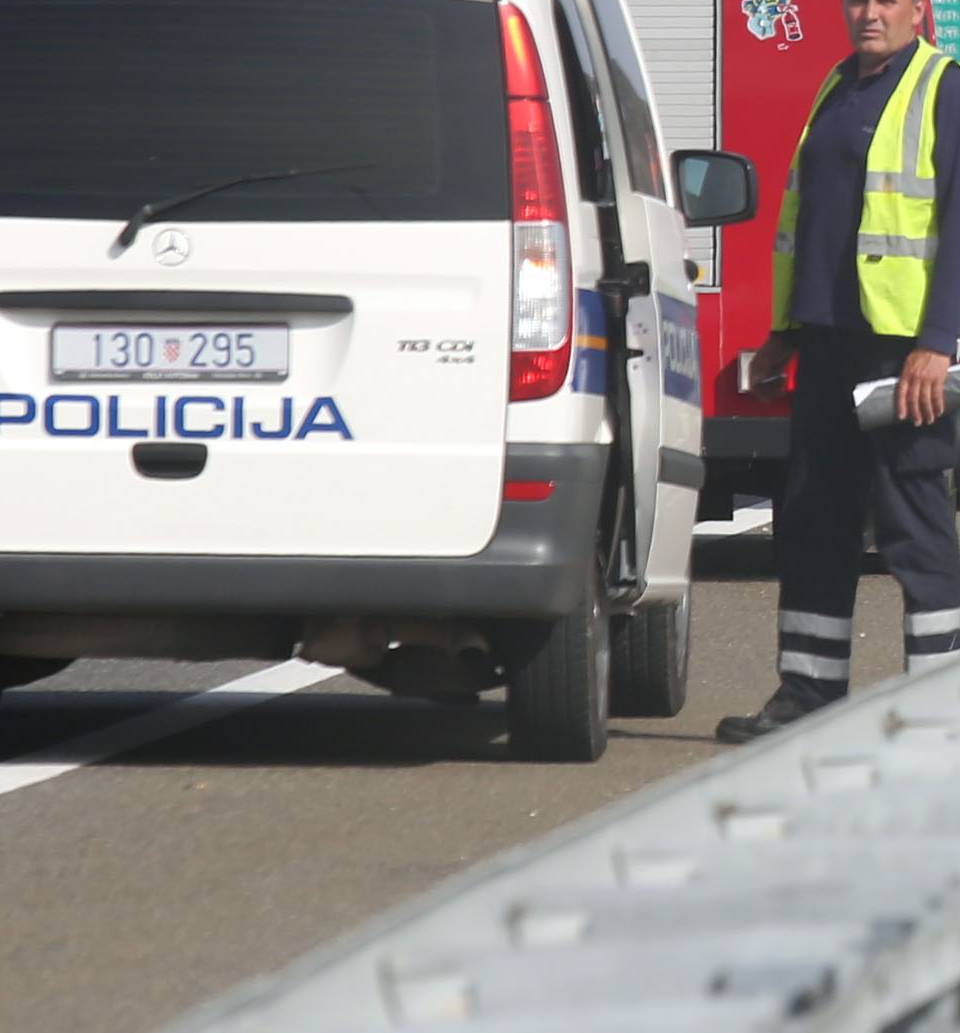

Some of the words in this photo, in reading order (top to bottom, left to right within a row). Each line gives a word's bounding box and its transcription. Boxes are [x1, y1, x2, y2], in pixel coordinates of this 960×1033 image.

[93, 332, 154, 368] 130
[188, 332, 255, 368] 295
[0, 393, 354, 440] POLICIJA
